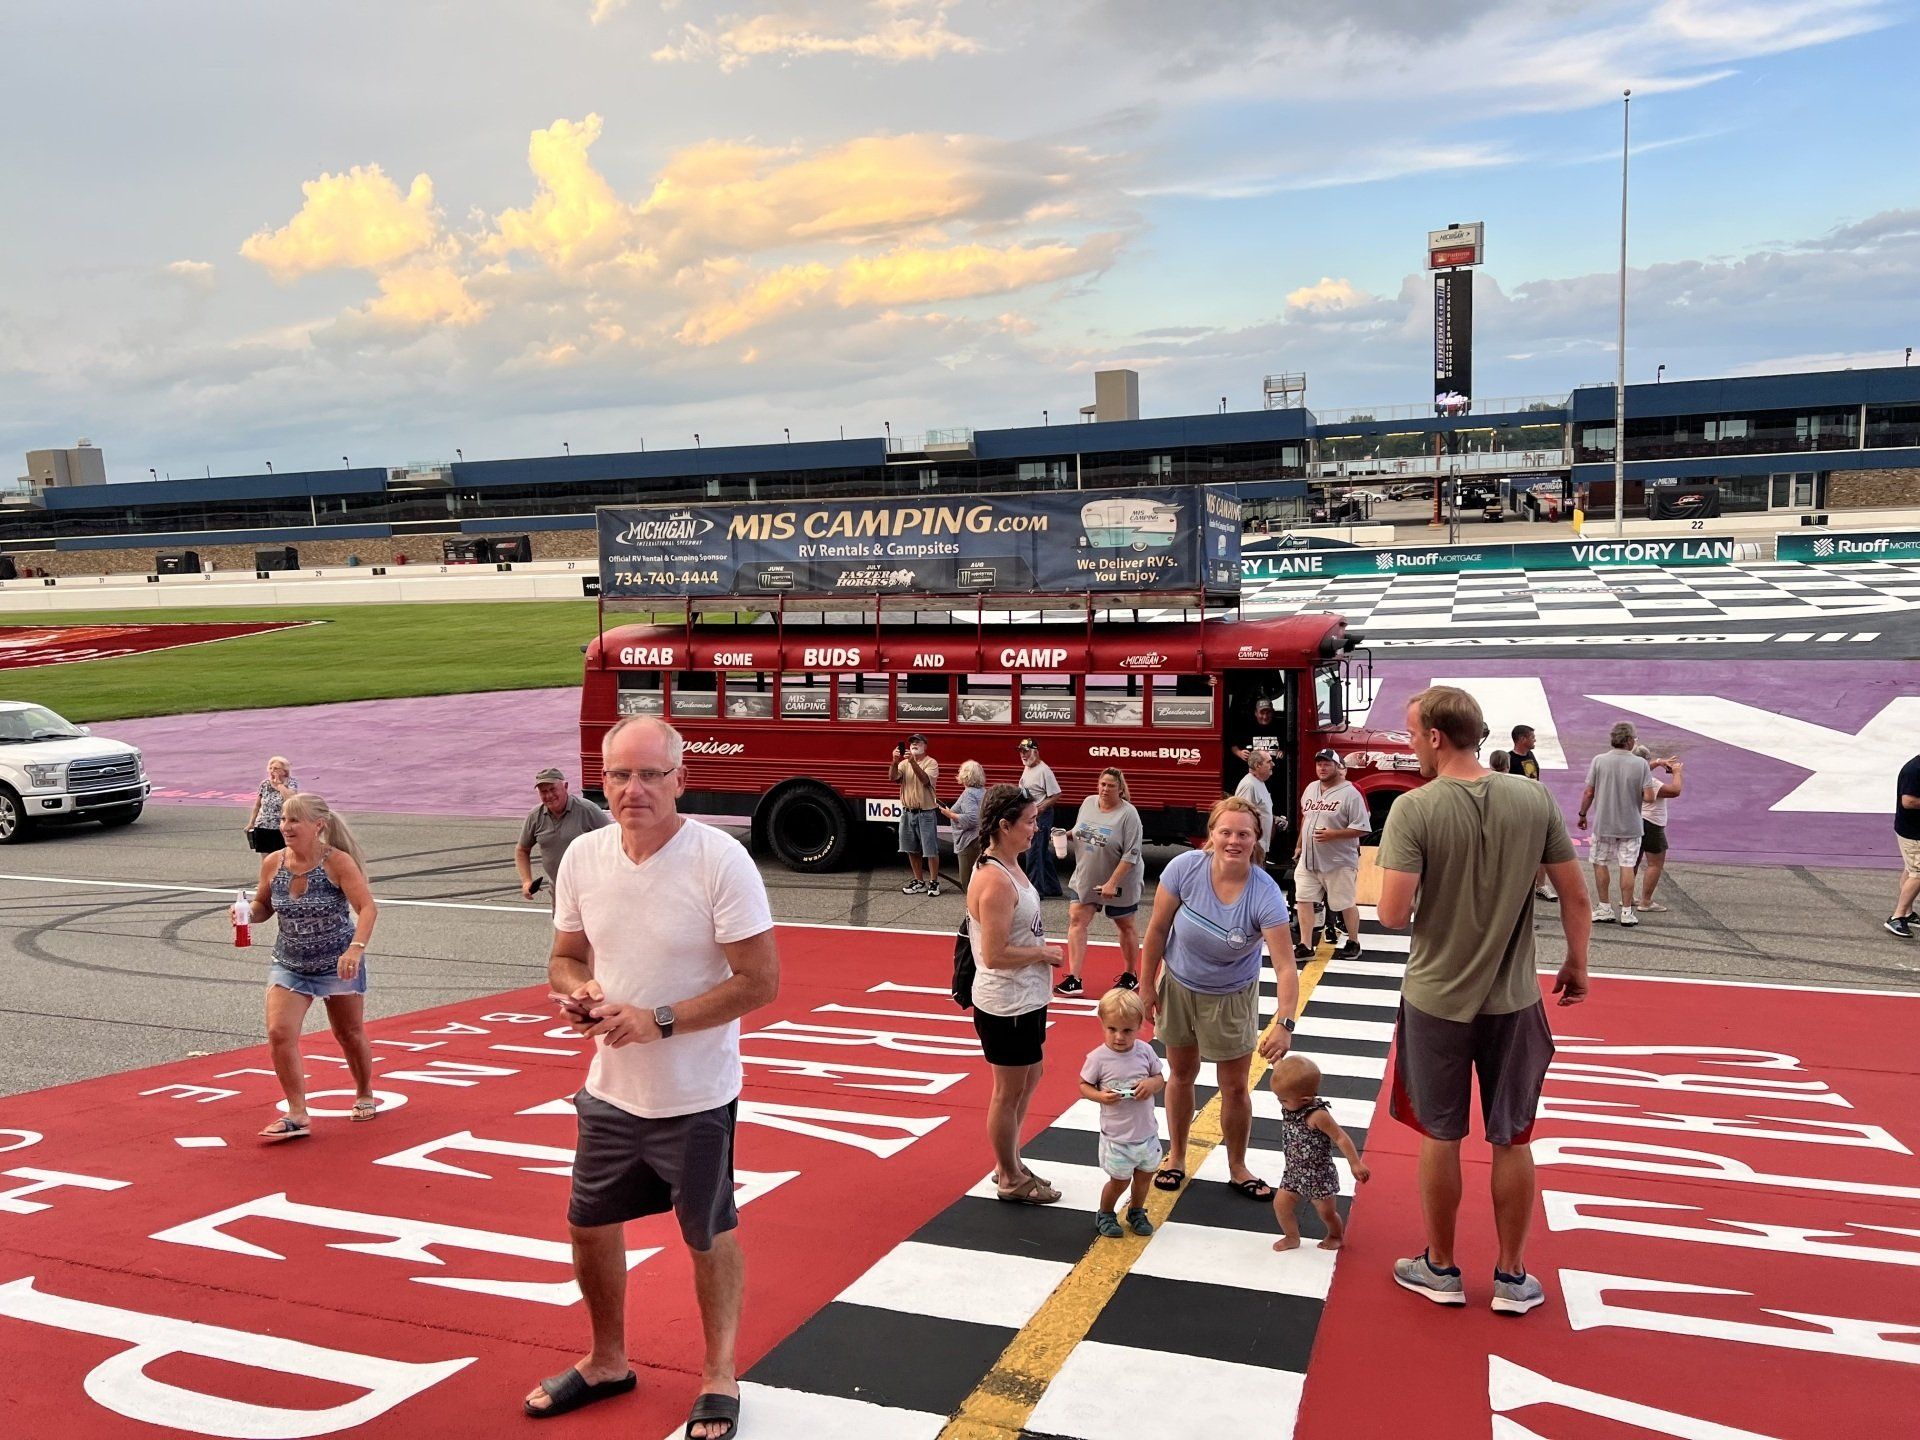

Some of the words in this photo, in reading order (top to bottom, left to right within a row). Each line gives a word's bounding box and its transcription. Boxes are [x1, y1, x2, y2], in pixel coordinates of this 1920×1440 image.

[627, 520, 698, 540] MICHIGAN
[726, 512, 797, 541] MIS
[1691, 520, 1704, 530] 22
[799, 545, 816, 558] RV
[819, 544, 869, 557] Rentals
[872, 543, 883, 557] &
[886, 541, 960, 558] Campsites
[1571, 541, 1676, 563] VICTORY
[1682, 541, 1733, 560] LAN
[1838, 538, 1889, 553] Ruoff
[608, 555, 631, 563] Official
[670, 554, 699, 563] Camping
[699, 553, 728, 562] Sponsor
[1076, 559, 1096, 570] We
[1099, 558, 1147, 570] Deliver
[1268, 556, 1323, 574] LANE
[1396, 552, 1439, 566] Ruoff
[1439, 553, 1482, 563] MORTGAGE
[568, 562, 575, 570] 27
[614, 570, 719, 586] 734-740-4444
[839, 570, 891, 579] FASTER
[1094, 570, 1118, 583] You
[1119, 568, 1160, 584] Enjoy.
[835, 578, 891, 587] HORSES
[619, 646, 674, 666] GRAB
[713, 652, 753, 667] SOME
[803, 647, 861, 667] BUDS
[913, 653, 945, 668] AND
[1000, 648, 1068, 668] CAMP
[1125, 655, 1160, 665] MICHIGAN
[788, 694, 806, 703] MIS
[785, 702, 827, 711] CAMPING
[1028, 703, 1048, 711] MIS
[1025, 711, 1071, 720] CAMPING
[1088, 746, 1130, 757] GRAB
[1130, 750, 1158, 758] SOME
[1158, 747, 1201, 759] BUDS
[868, 802, 902, 818] Mob
[1304, 798, 1340, 812] Detroit
[803, 835, 835, 862] GOODYEAR
